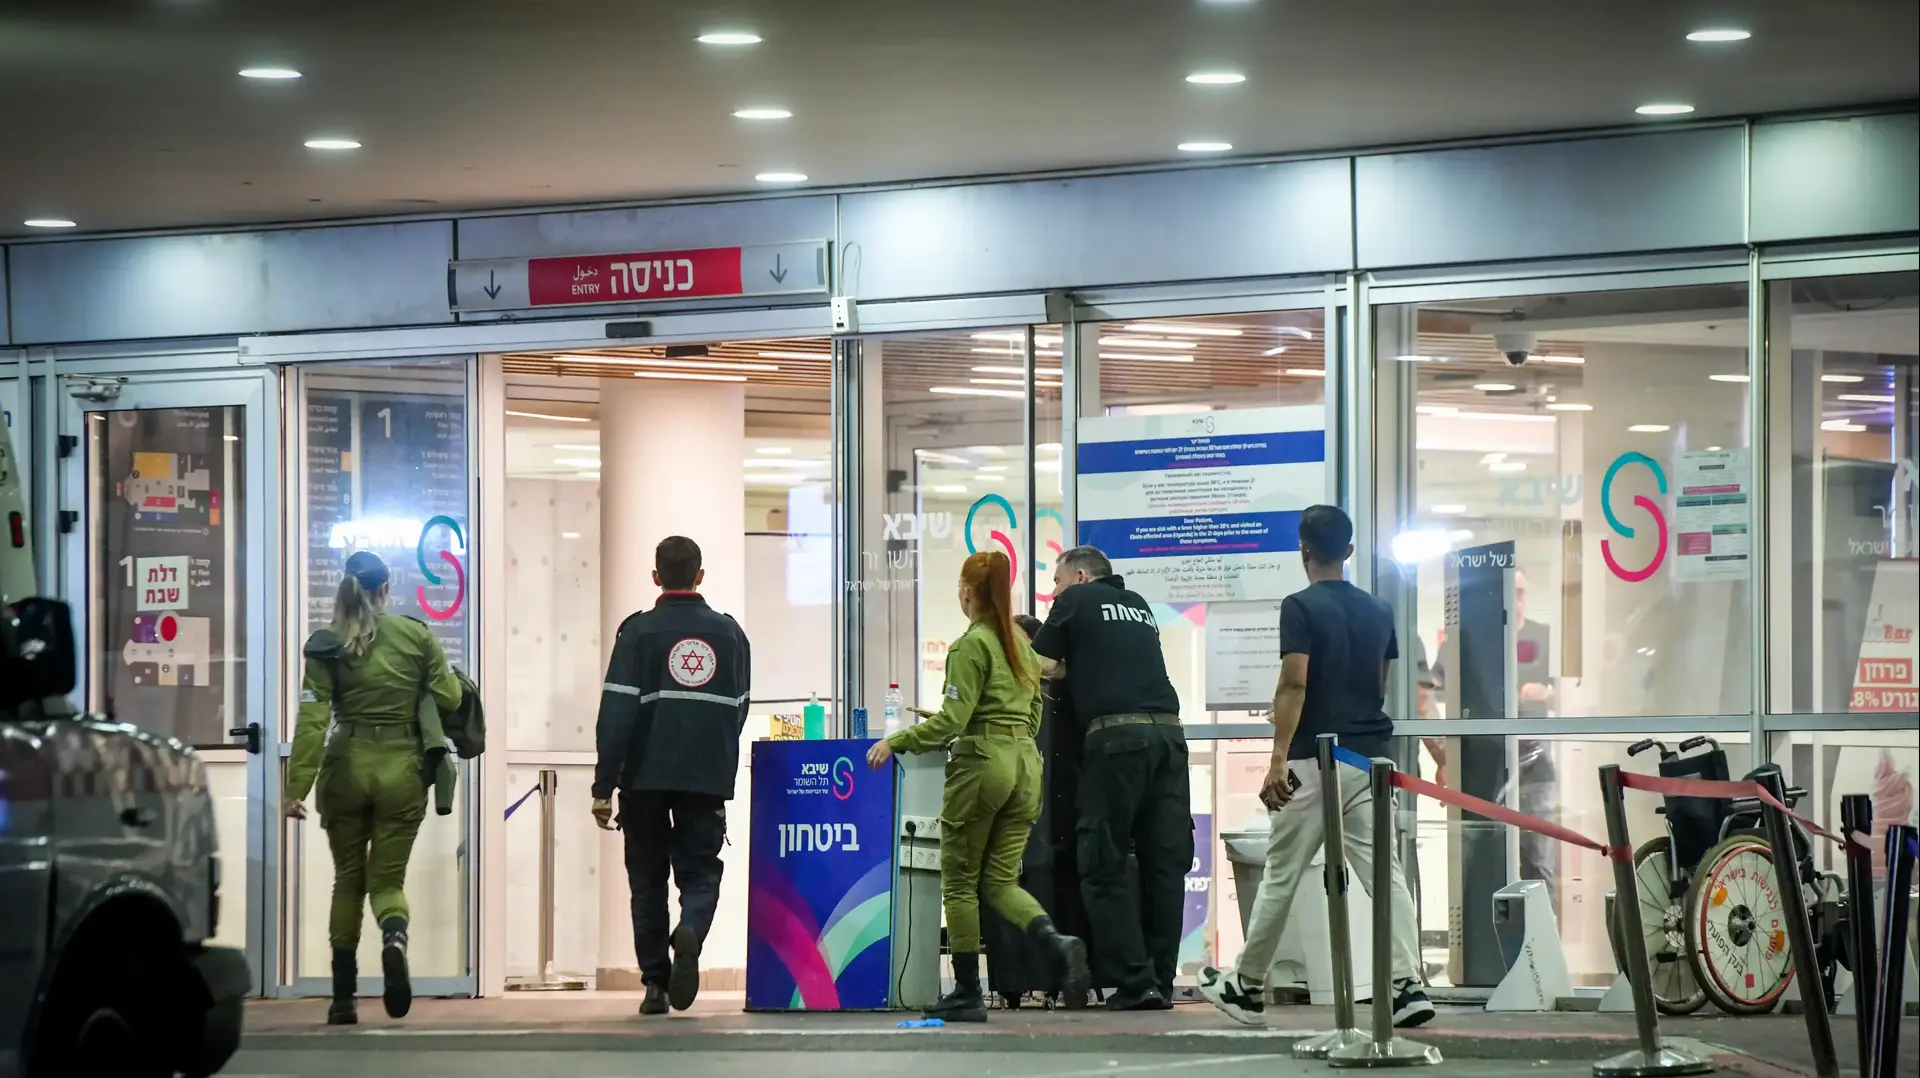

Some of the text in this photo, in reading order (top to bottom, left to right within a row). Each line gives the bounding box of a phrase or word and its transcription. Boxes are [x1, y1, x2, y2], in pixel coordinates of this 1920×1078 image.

[573, 265, 598, 281] دخول
[610, 259, 694, 294] כניסה
[571, 283, 600, 295] ENTRY
[377, 408, 391, 438] 1
[1489, 550, 1507, 567] של
[119, 555, 133, 587] 1
[148, 563, 177, 583] דלת
[145, 588, 179, 604] שבת
[1864, 662, 1907, 682] פרוזן
[801, 763, 829, 775] שיבא
[794, 775, 829, 787] תל השומר
[778, 823, 860, 857] ביטחון
[1706, 918, 1744, 977] בנק הפועלי
